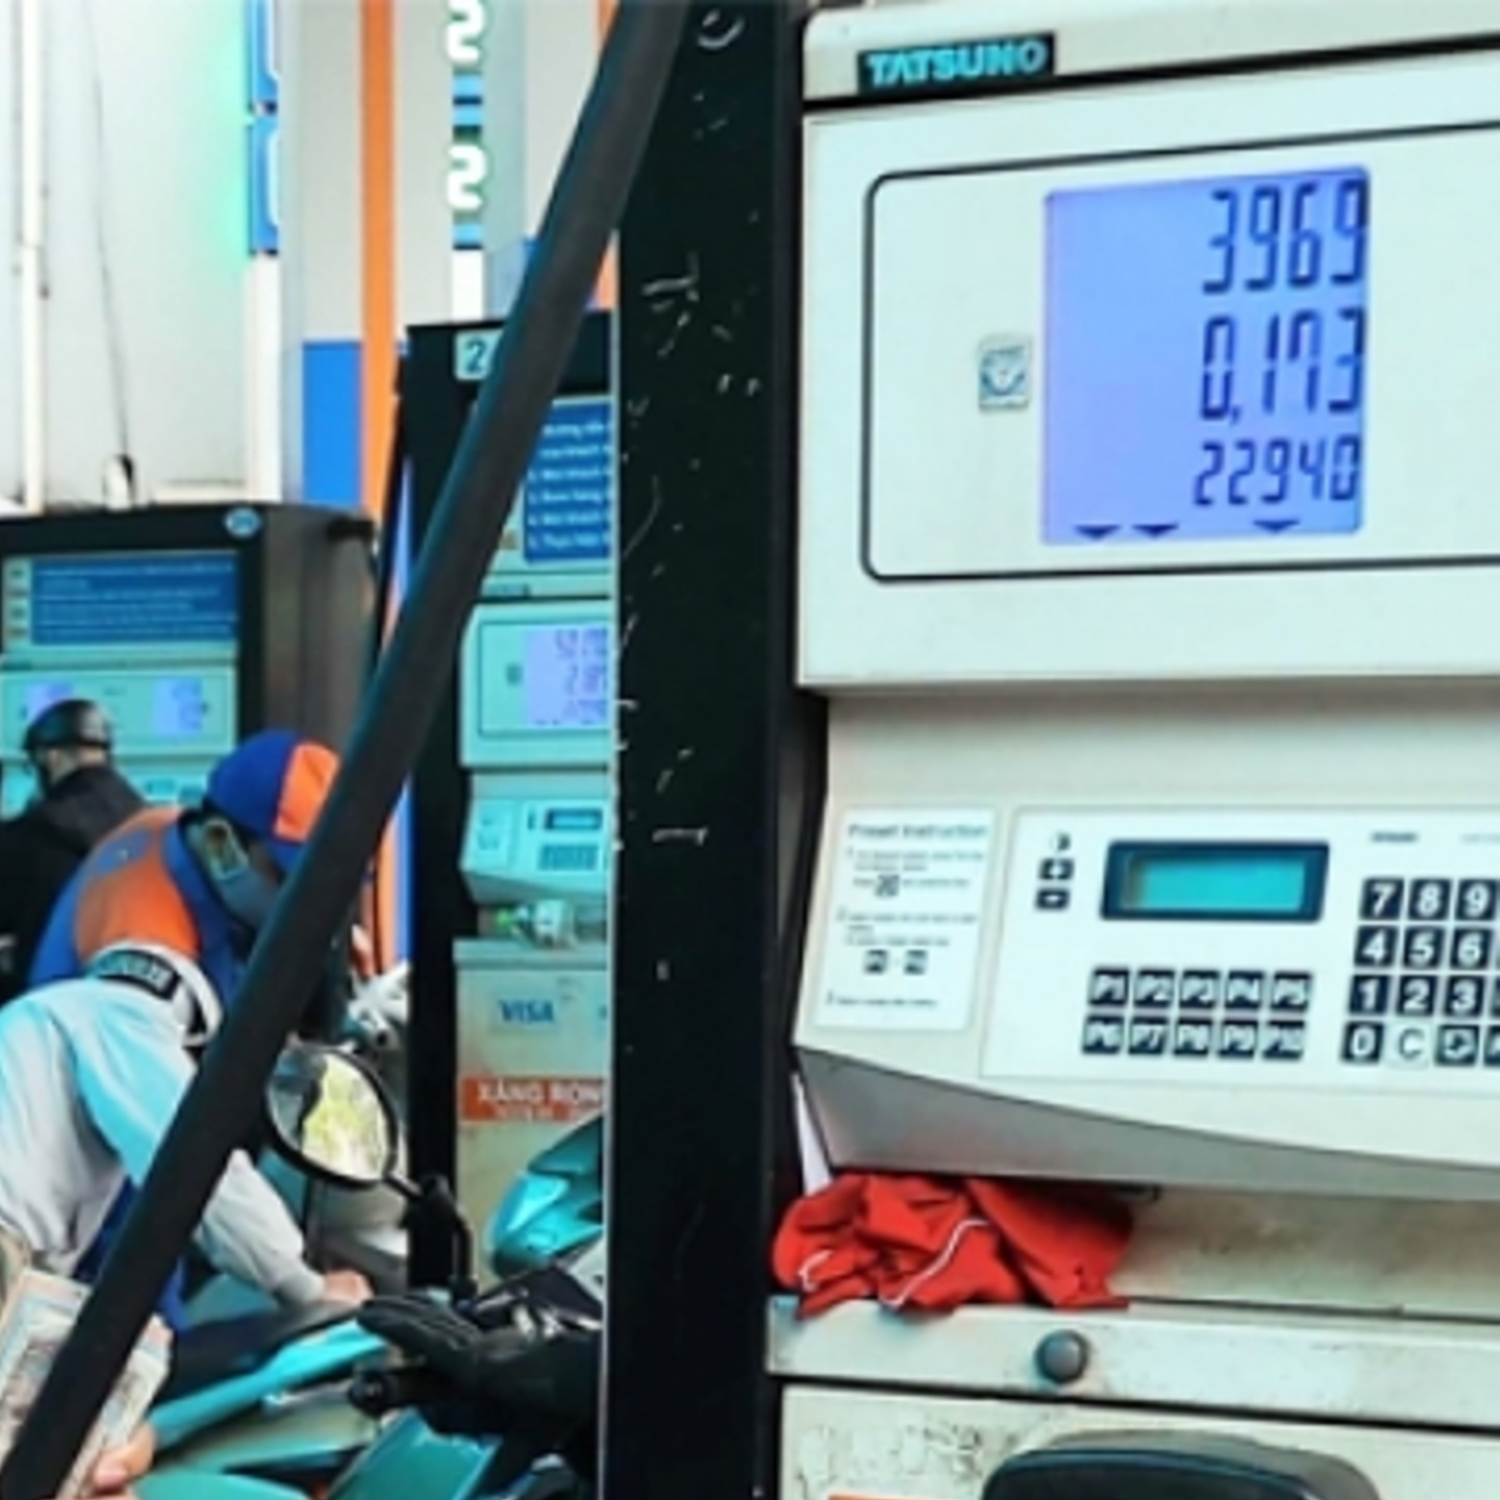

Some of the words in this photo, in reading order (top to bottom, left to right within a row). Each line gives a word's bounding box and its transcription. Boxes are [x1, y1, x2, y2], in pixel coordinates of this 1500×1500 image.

[866, 38, 1049, 88] TATSUNO
[1201, 178, 1370, 296] 3969
[1199, 307, 1367, 425] 0,173
[1192, 433, 1362, 506] 22940
[1371, 882, 1396, 918] 7
[1417, 882, 1442, 918] 8
[1465, 882, 1490, 918] 9
[1362, 929, 1386, 964] 4
[1408, 932, 1434, 967] 5
[1457, 932, 1483, 968] 6
[498, 999, 555, 1023] VISA
[1359, 978, 1379, 1012] 1
[1403, 978, 1430, 1012] 2
[1452, 979, 1477, 1013] 3
[1352, 1025, 1376, 1059] 0
[1398, 1027, 1425, 1061] C
